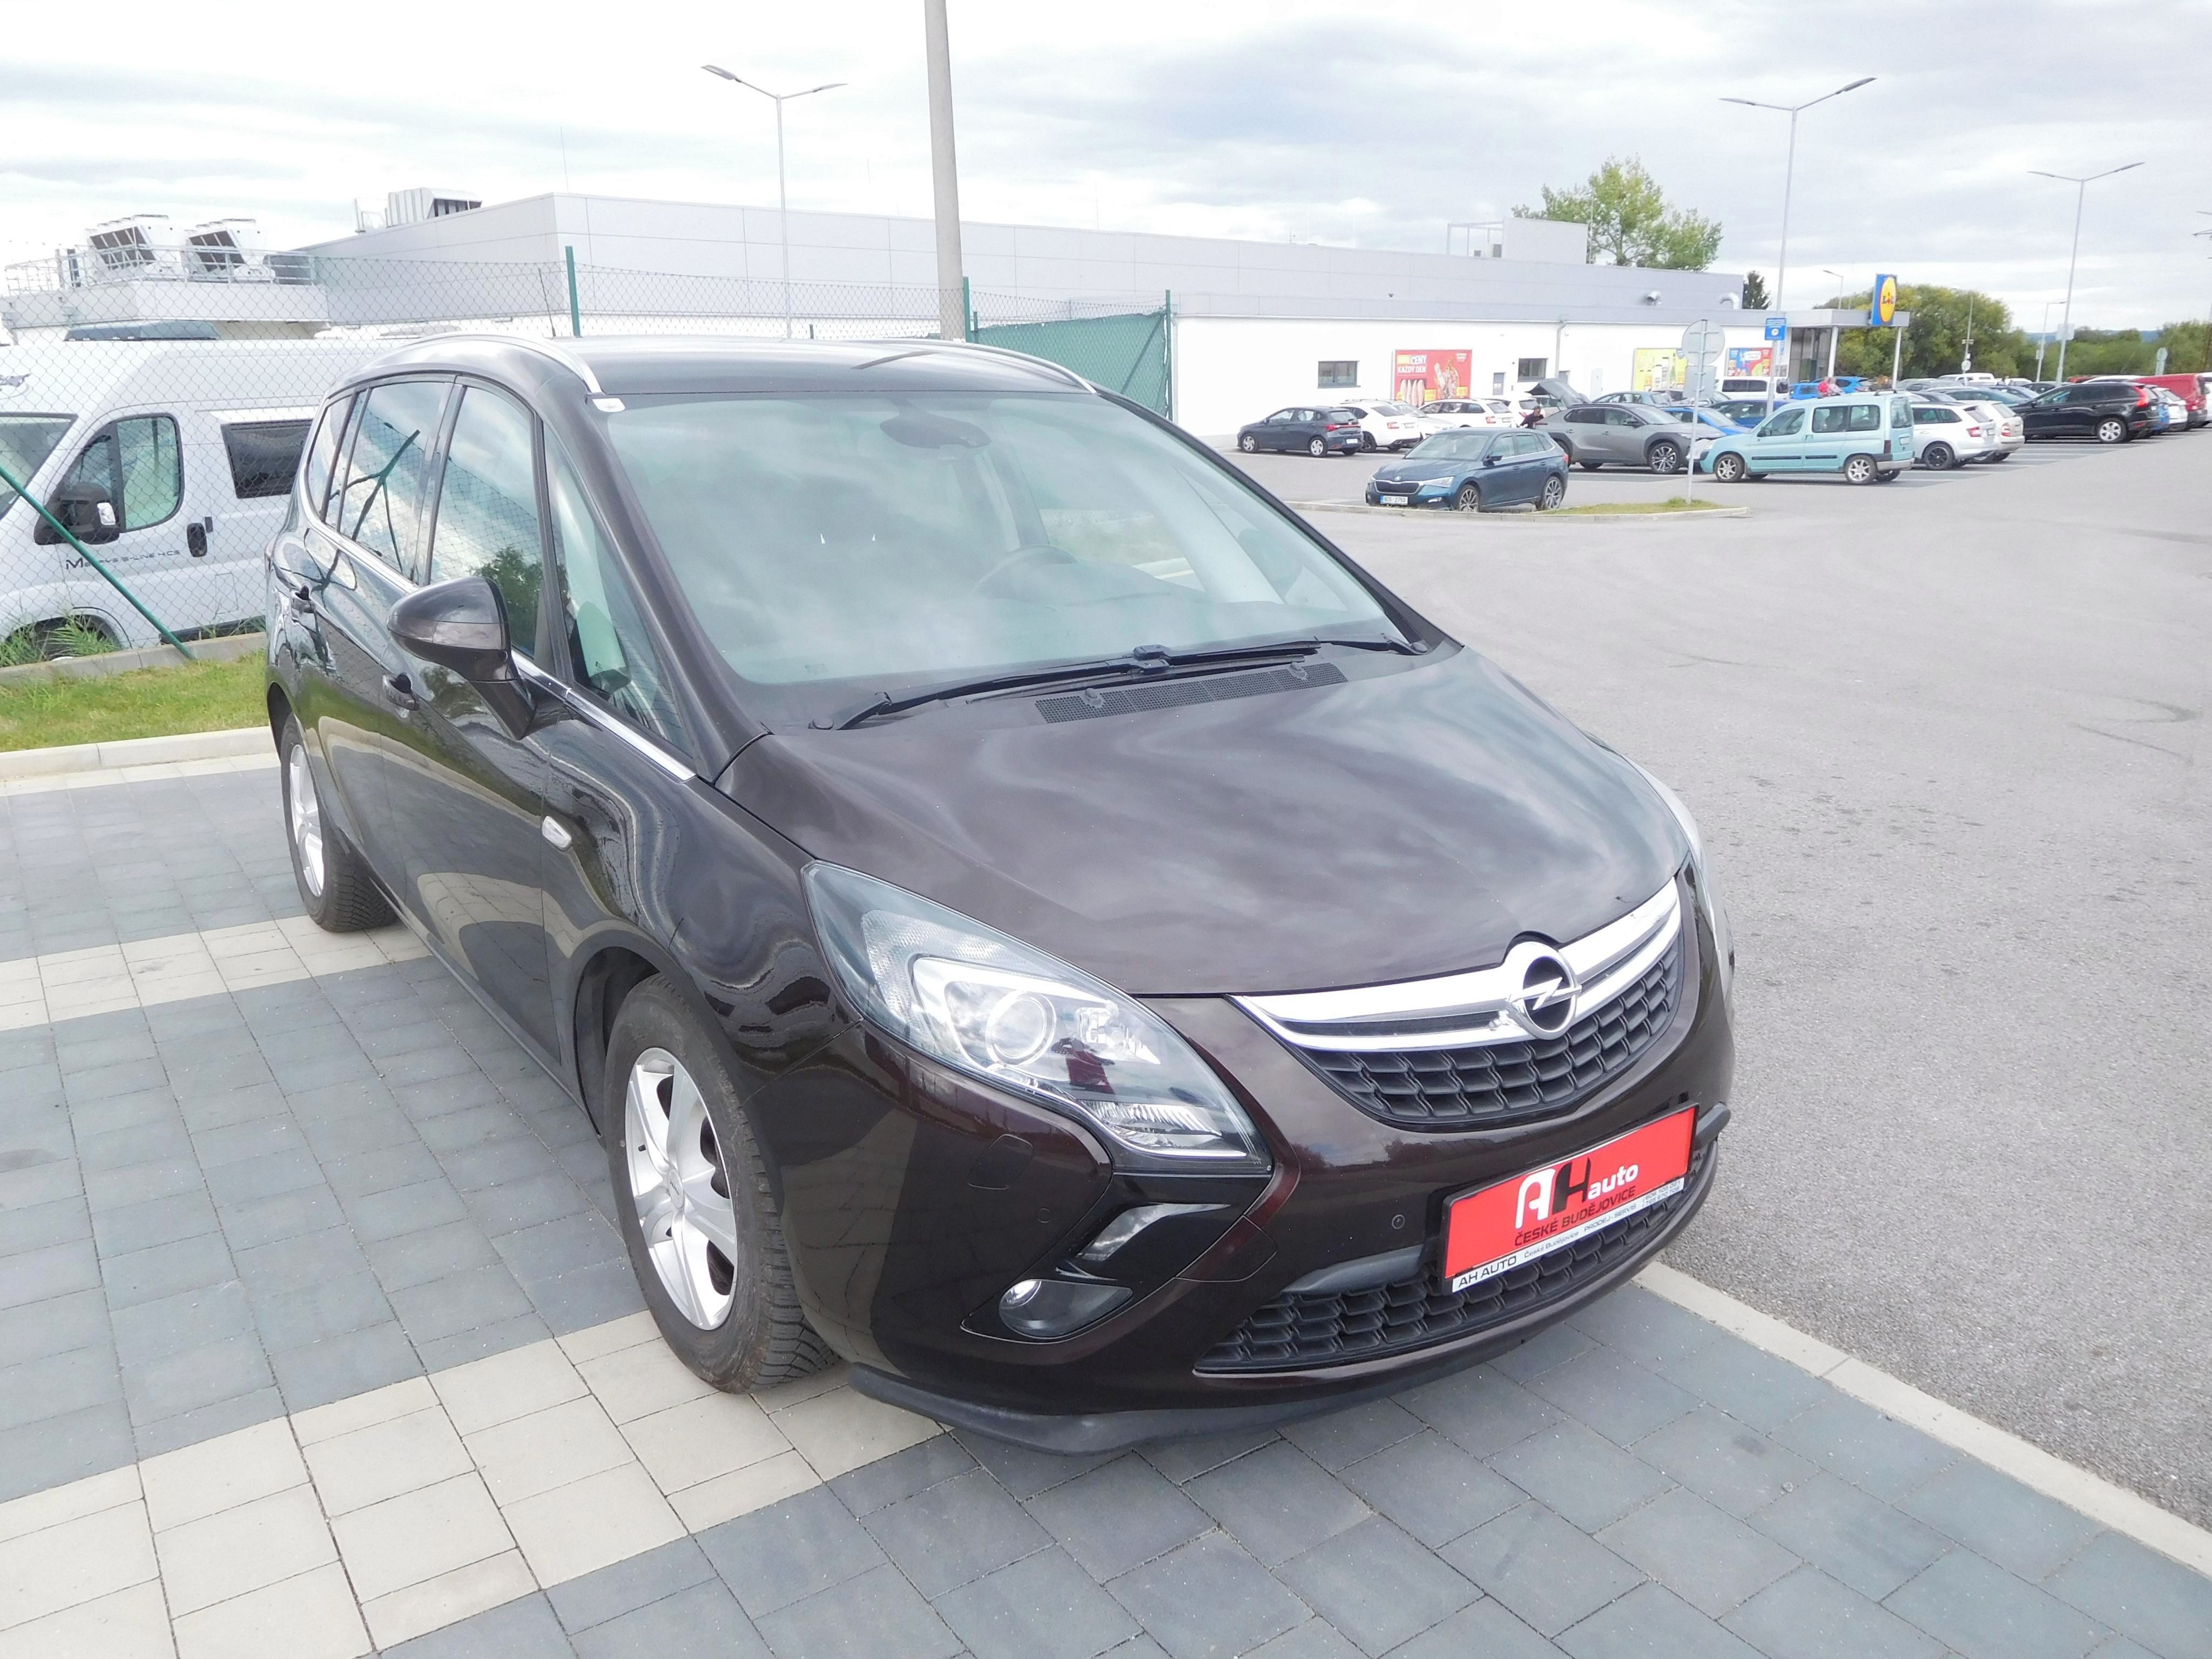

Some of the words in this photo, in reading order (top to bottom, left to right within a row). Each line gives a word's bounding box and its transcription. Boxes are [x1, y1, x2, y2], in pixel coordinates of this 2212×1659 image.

[1514, 1218, 1559, 1246] ČESKÉ
[1561, 1186, 1636, 1229] BUDĚJOVICE
[1458, 1271, 1478, 1287] AH
[1481, 1256, 1516, 1278] AUTO
